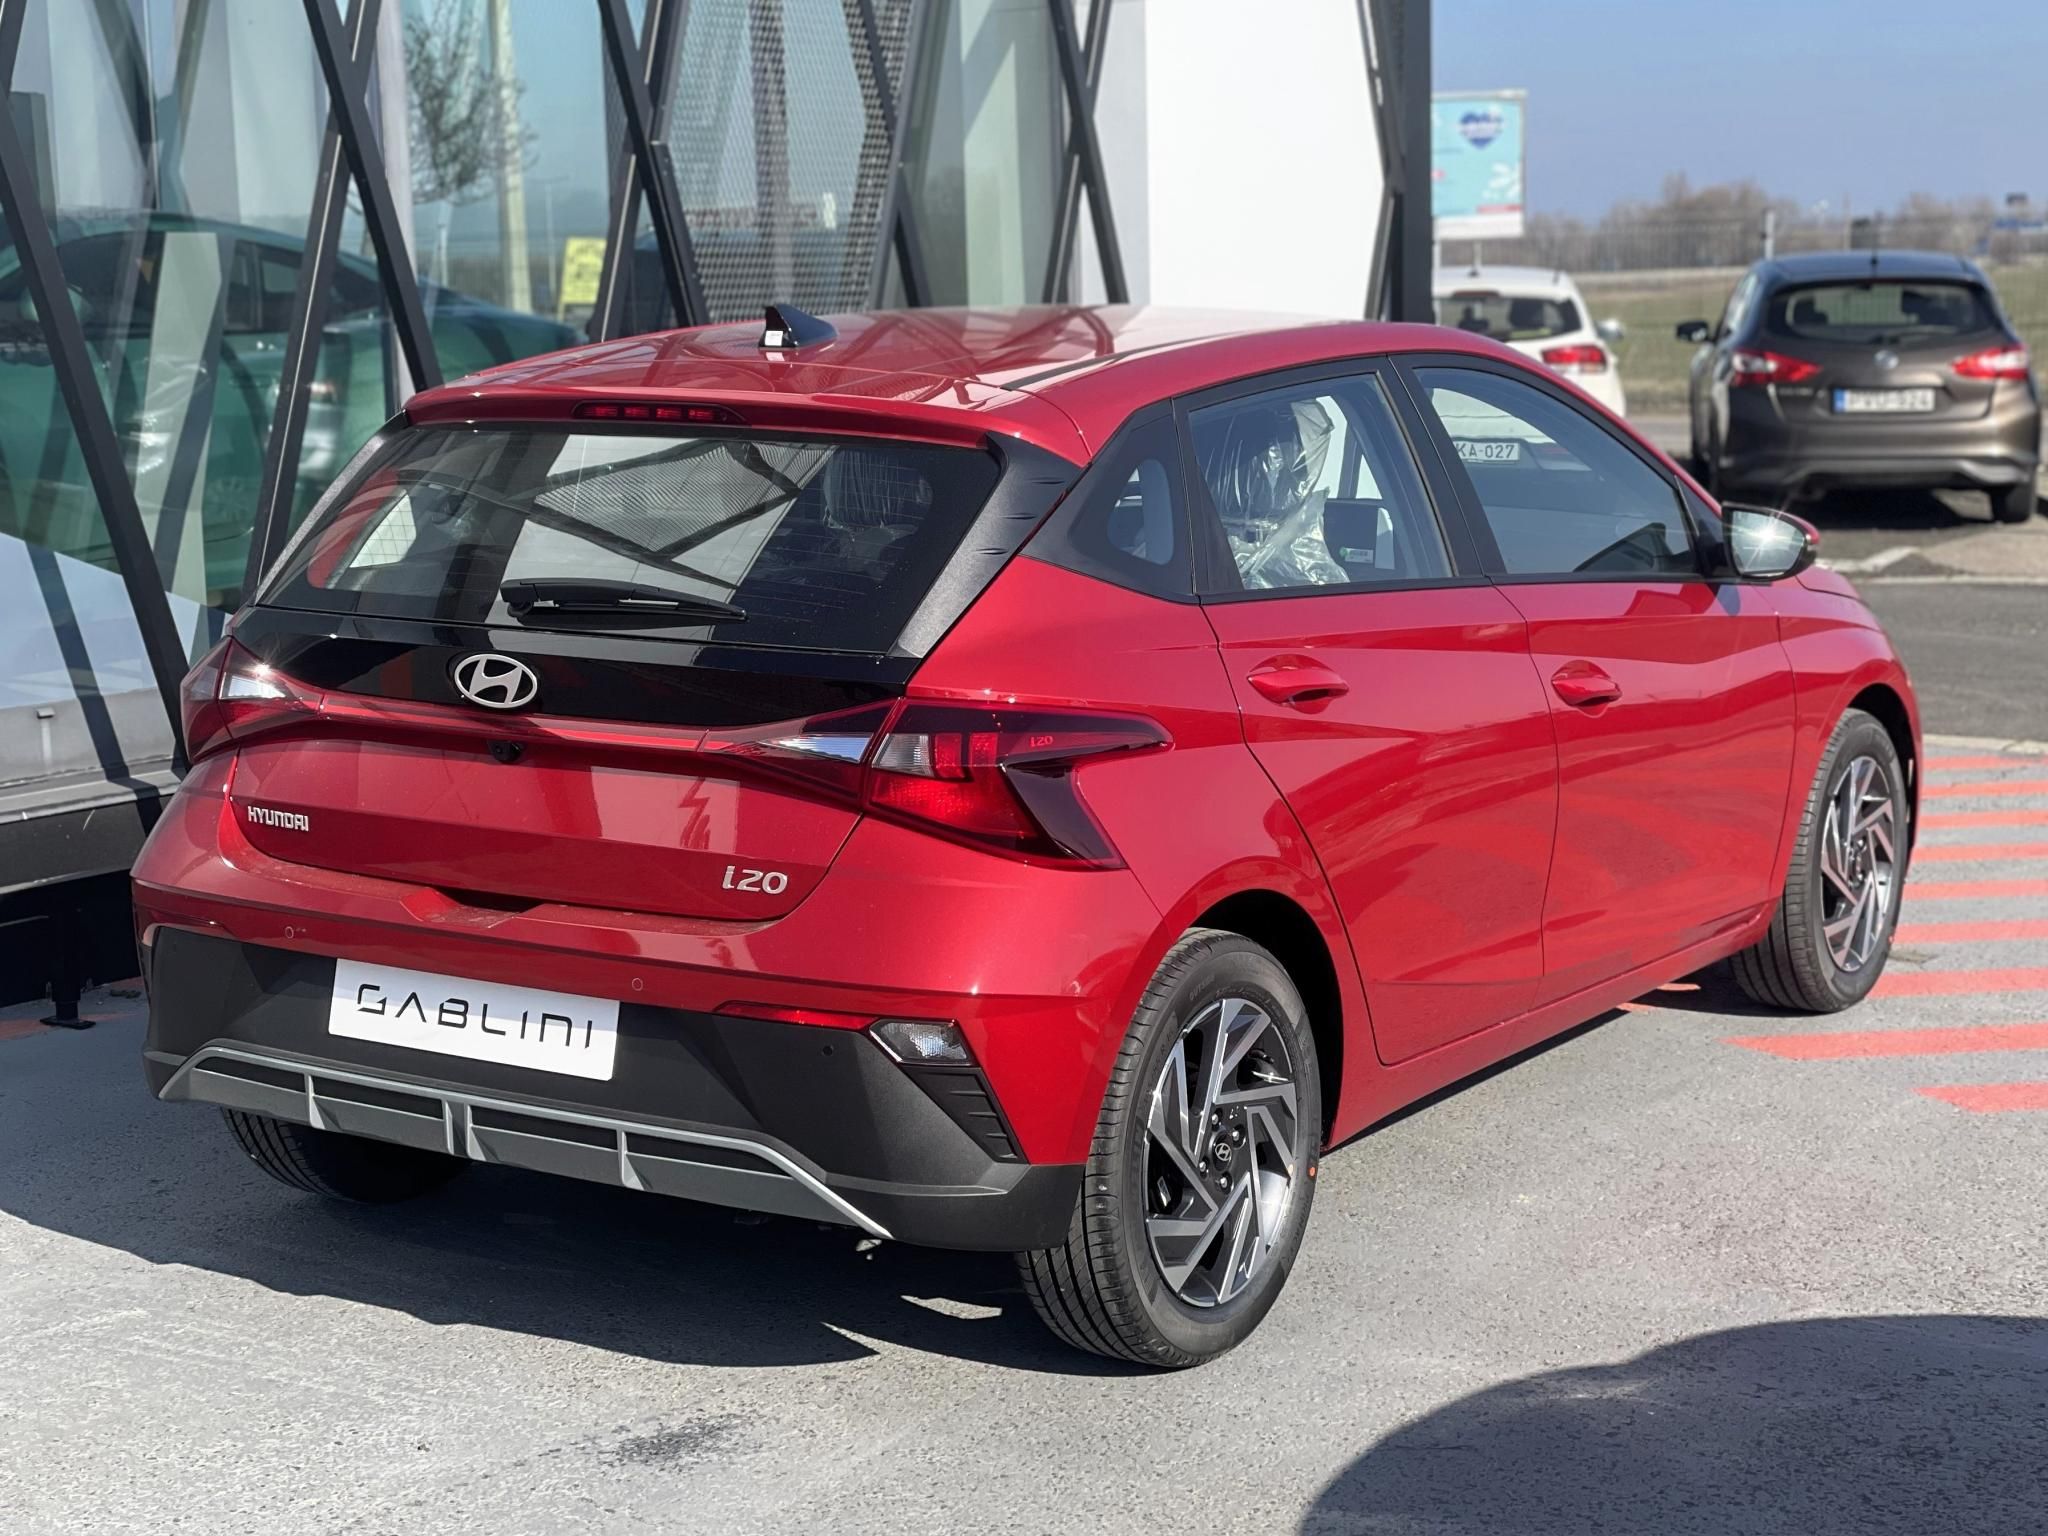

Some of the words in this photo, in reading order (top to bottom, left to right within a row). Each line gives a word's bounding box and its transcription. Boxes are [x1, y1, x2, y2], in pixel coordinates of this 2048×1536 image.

[247, 805, 309, 832] HYUNDAI
[722, 865, 788, 894] i20
[357, 983, 593, 1049] GABLINI
